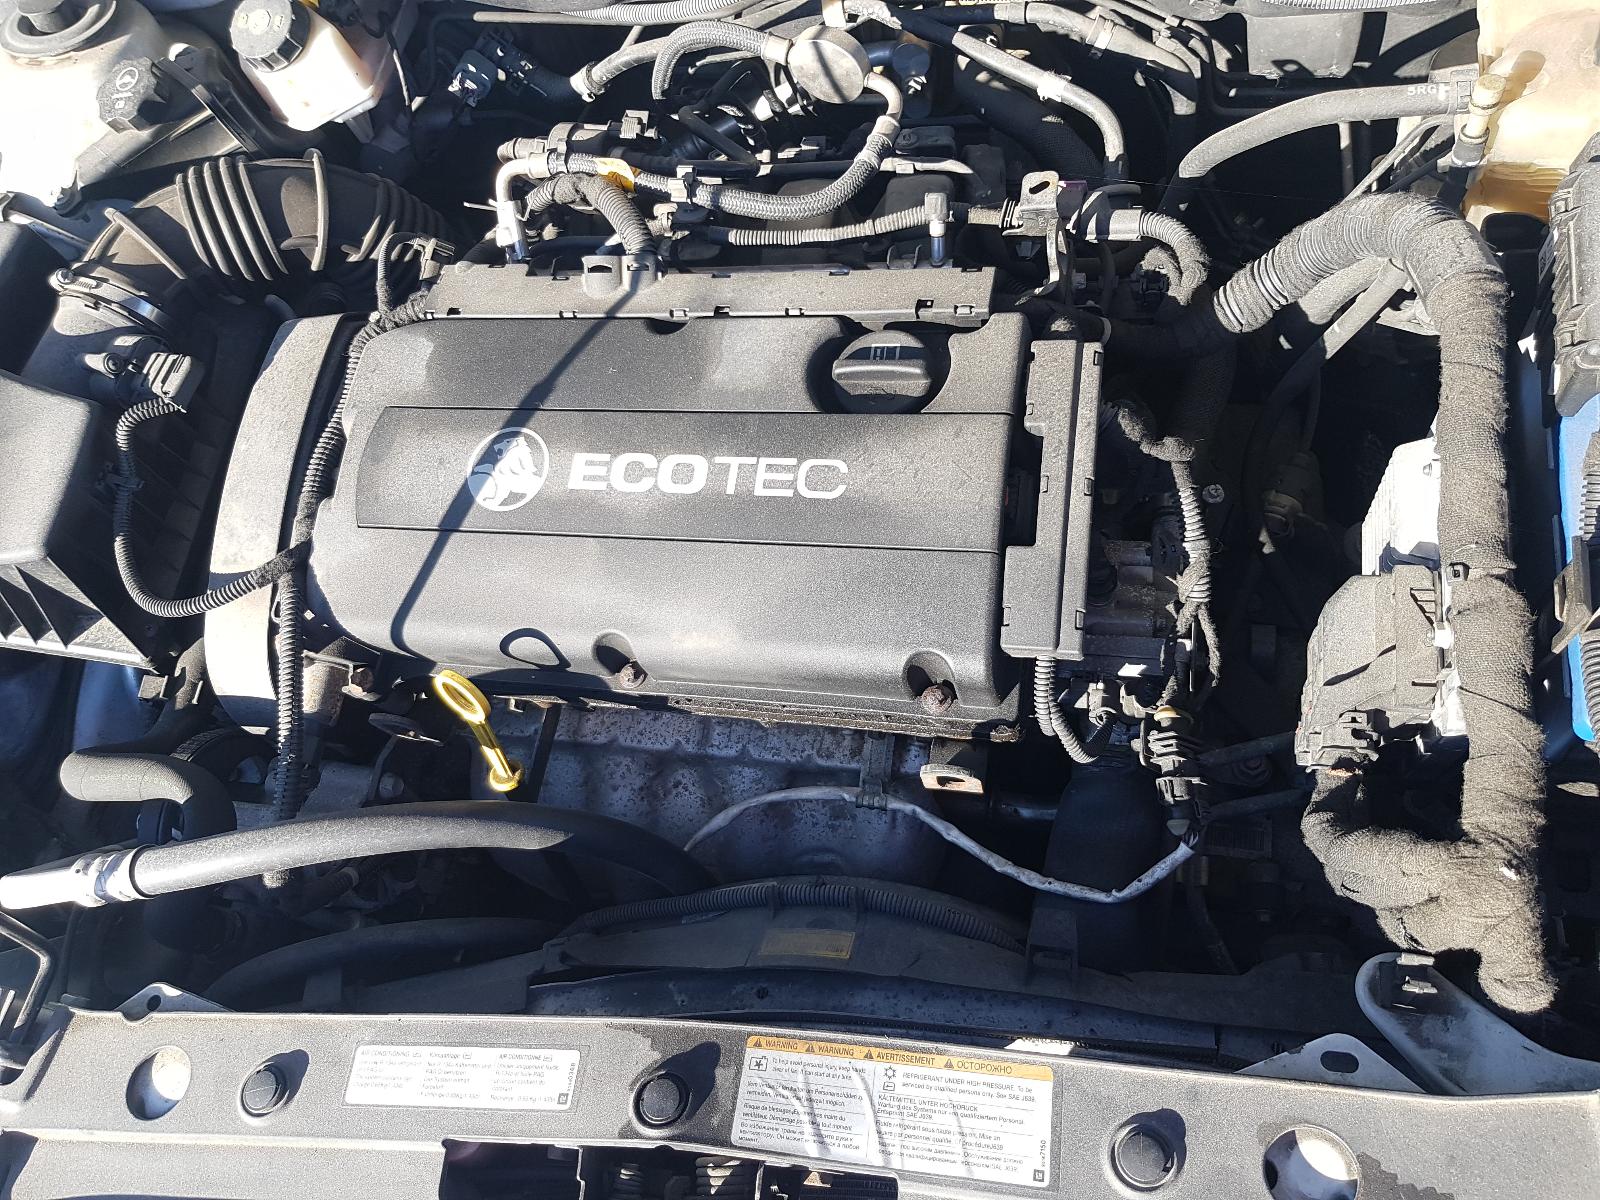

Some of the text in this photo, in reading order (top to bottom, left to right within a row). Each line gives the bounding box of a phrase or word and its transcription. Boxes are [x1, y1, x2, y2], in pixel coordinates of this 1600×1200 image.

[567, 452, 849, 500] ECOTEC
[764, 1039, 798, 1050] WARNING
[817, 1044, 854, 1056] WARNUNG
[876, 1050, 935, 1065] AVERTISSEMENT
[956, 1059, 1012, 1074] ОСТОРОЖНО
[902, 1071, 943, 1082] REFRIGERANT
[944, 1076, 964, 1085] UNDER
[966, 1079, 981, 1087] HIGH
[918, 1098, 938, 1107] UNTER
